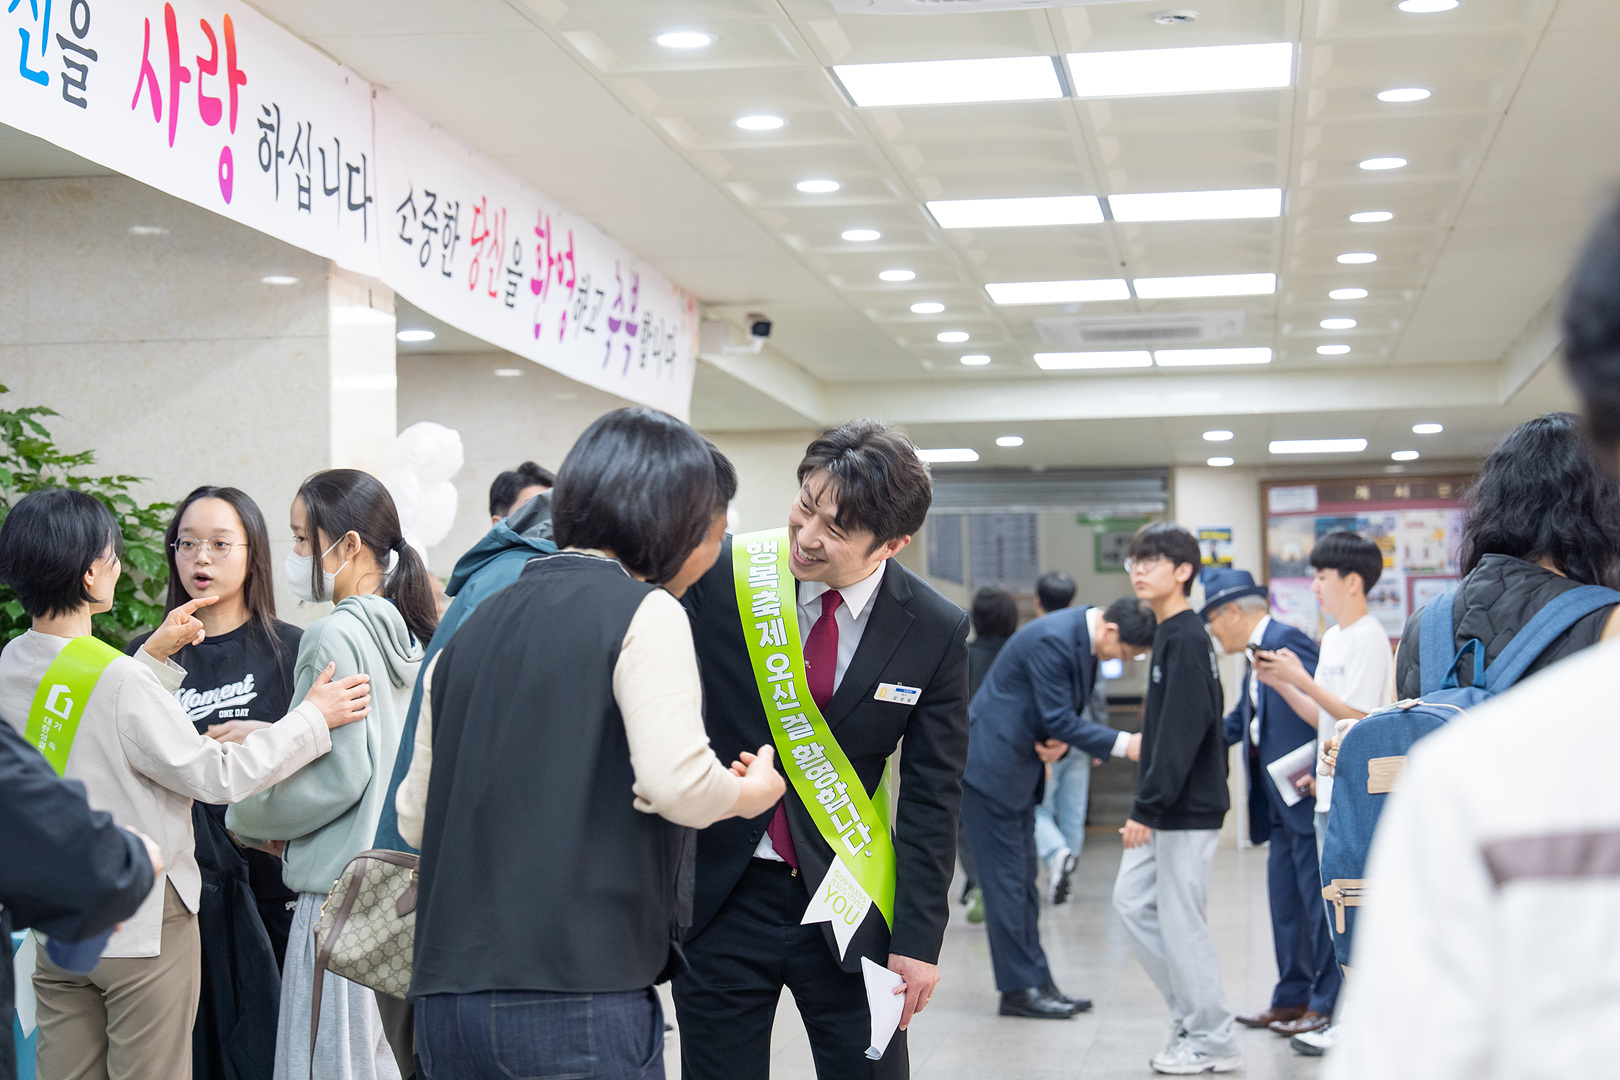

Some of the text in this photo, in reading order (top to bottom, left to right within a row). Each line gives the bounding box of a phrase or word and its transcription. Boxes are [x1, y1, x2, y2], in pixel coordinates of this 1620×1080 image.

[396, 181, 461, 278] 소중한
[469, 195, 523, 308] 당신을
[174, 673, 255, 713] Moment
[745, 540, 789, 648] 행복축제
[791, 741, 873, 857] 환영합니다
[218, 708, 250, 719] ONE DAY
[824, 884, 860, 926] YOU
[830, 877, 865, 911] JESUS LOVES
[833, 869, 867, 904] GOD BLESS
